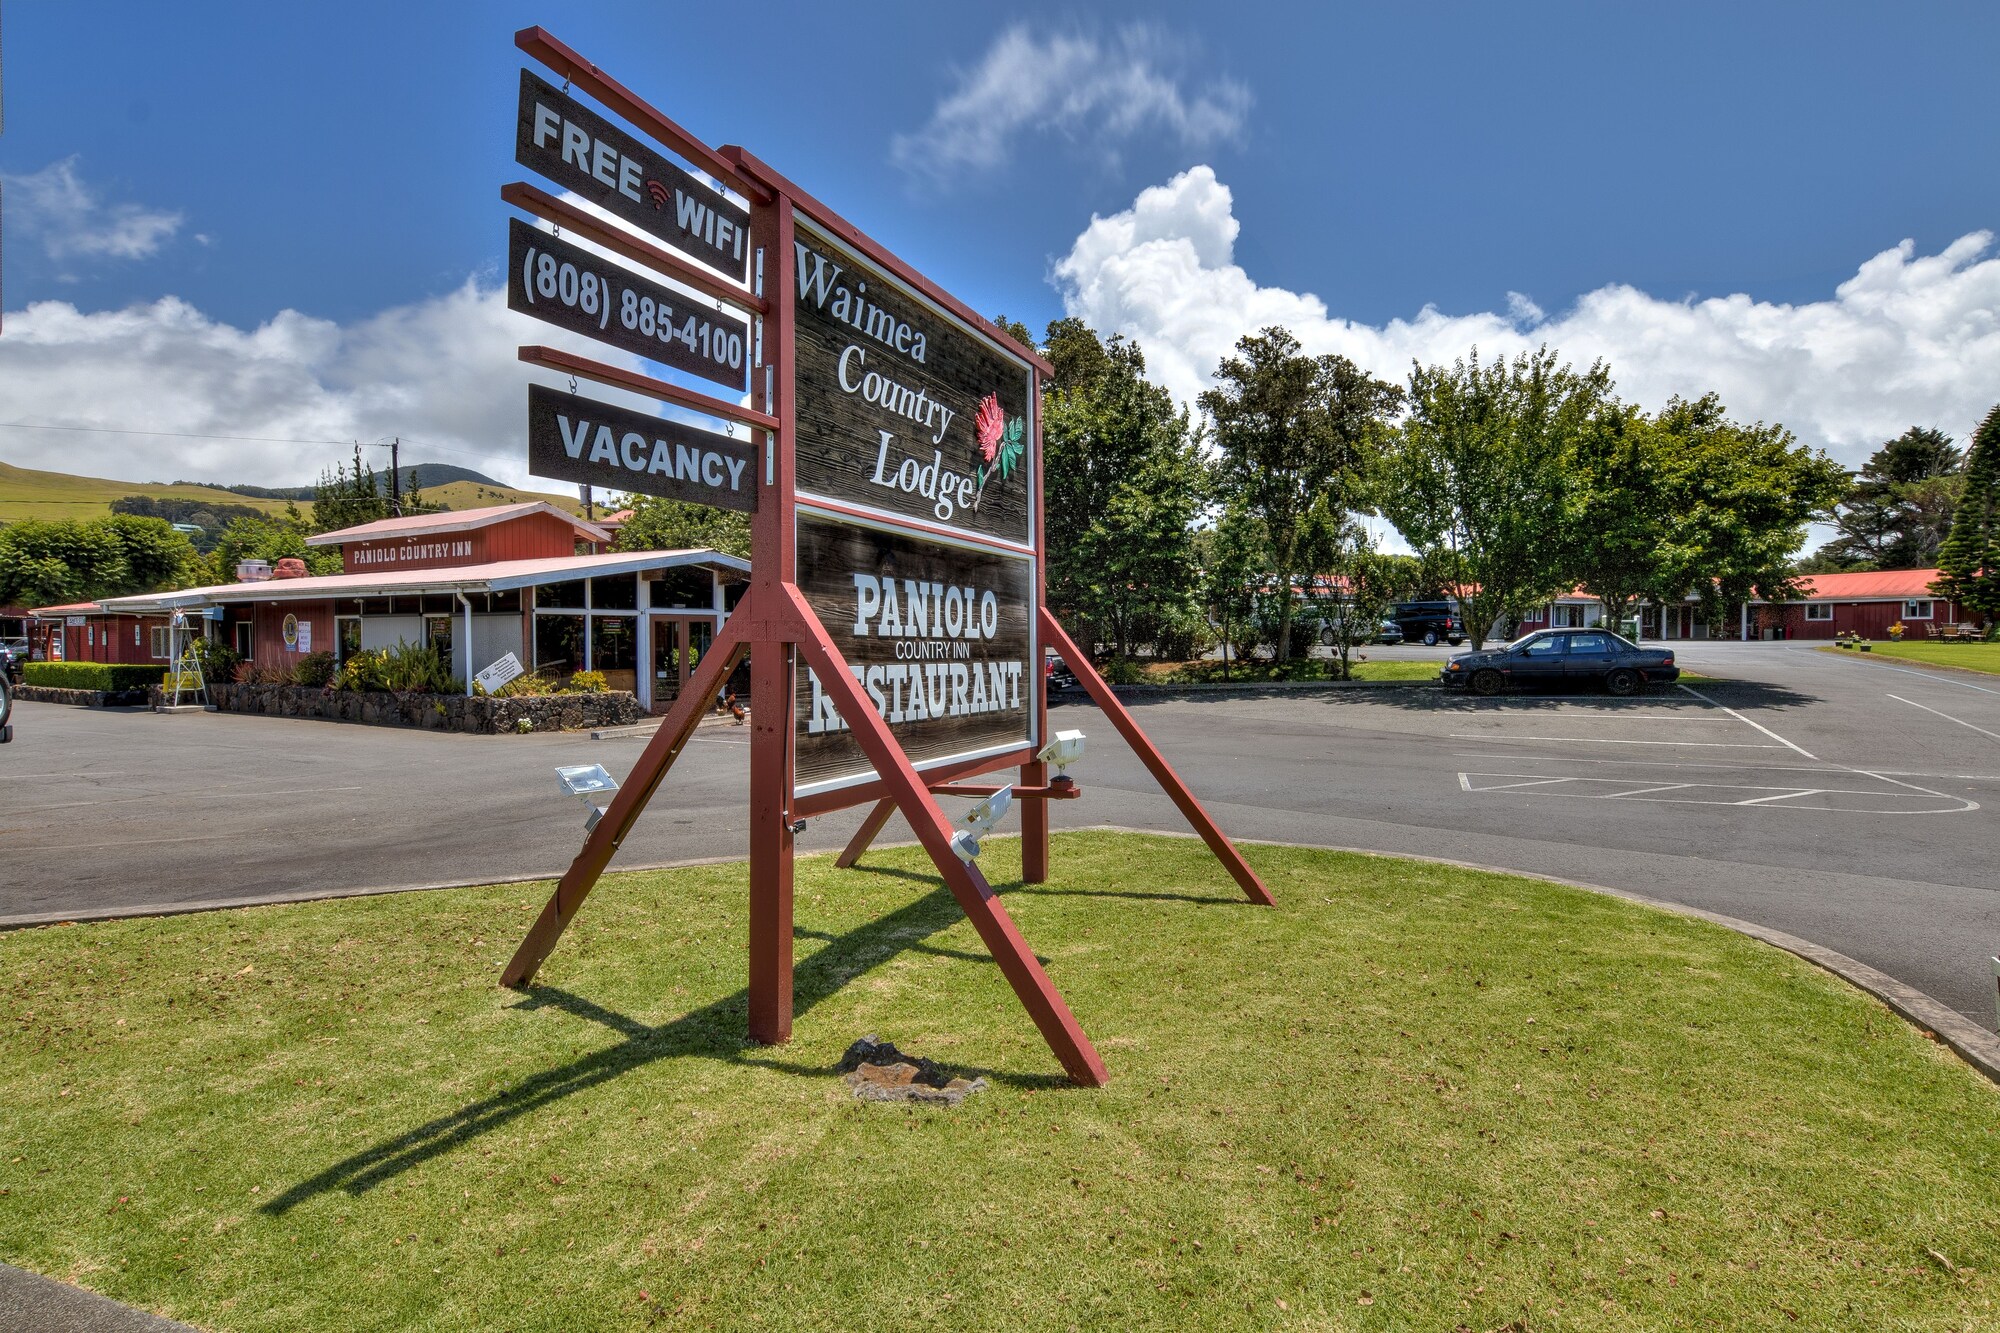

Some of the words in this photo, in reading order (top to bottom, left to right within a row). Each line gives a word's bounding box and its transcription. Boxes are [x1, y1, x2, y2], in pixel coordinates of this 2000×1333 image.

[534, 102, 643, 204] FREE
[675, 188, 743, 261] WIFI
[523, 247, 610, 329] (808)
[620, 289, 742, 369] 885-4100
[794, 241, 927, 364] Waimea
[838, 345, 956, 444] Country
[556, 414, 747, 491] VACANCY
[869, 430, 973, 520] Lodge
[354, 547, 396, 564] PANIOLO
[400, 543, 449, 561] COUNTRY
[452, 541, 472, 557] INN
[853, 573, 998, 639] PANIOLO
[895, 641, 951, 660] COUNTRY
[953, 641, 970, 659] INN
